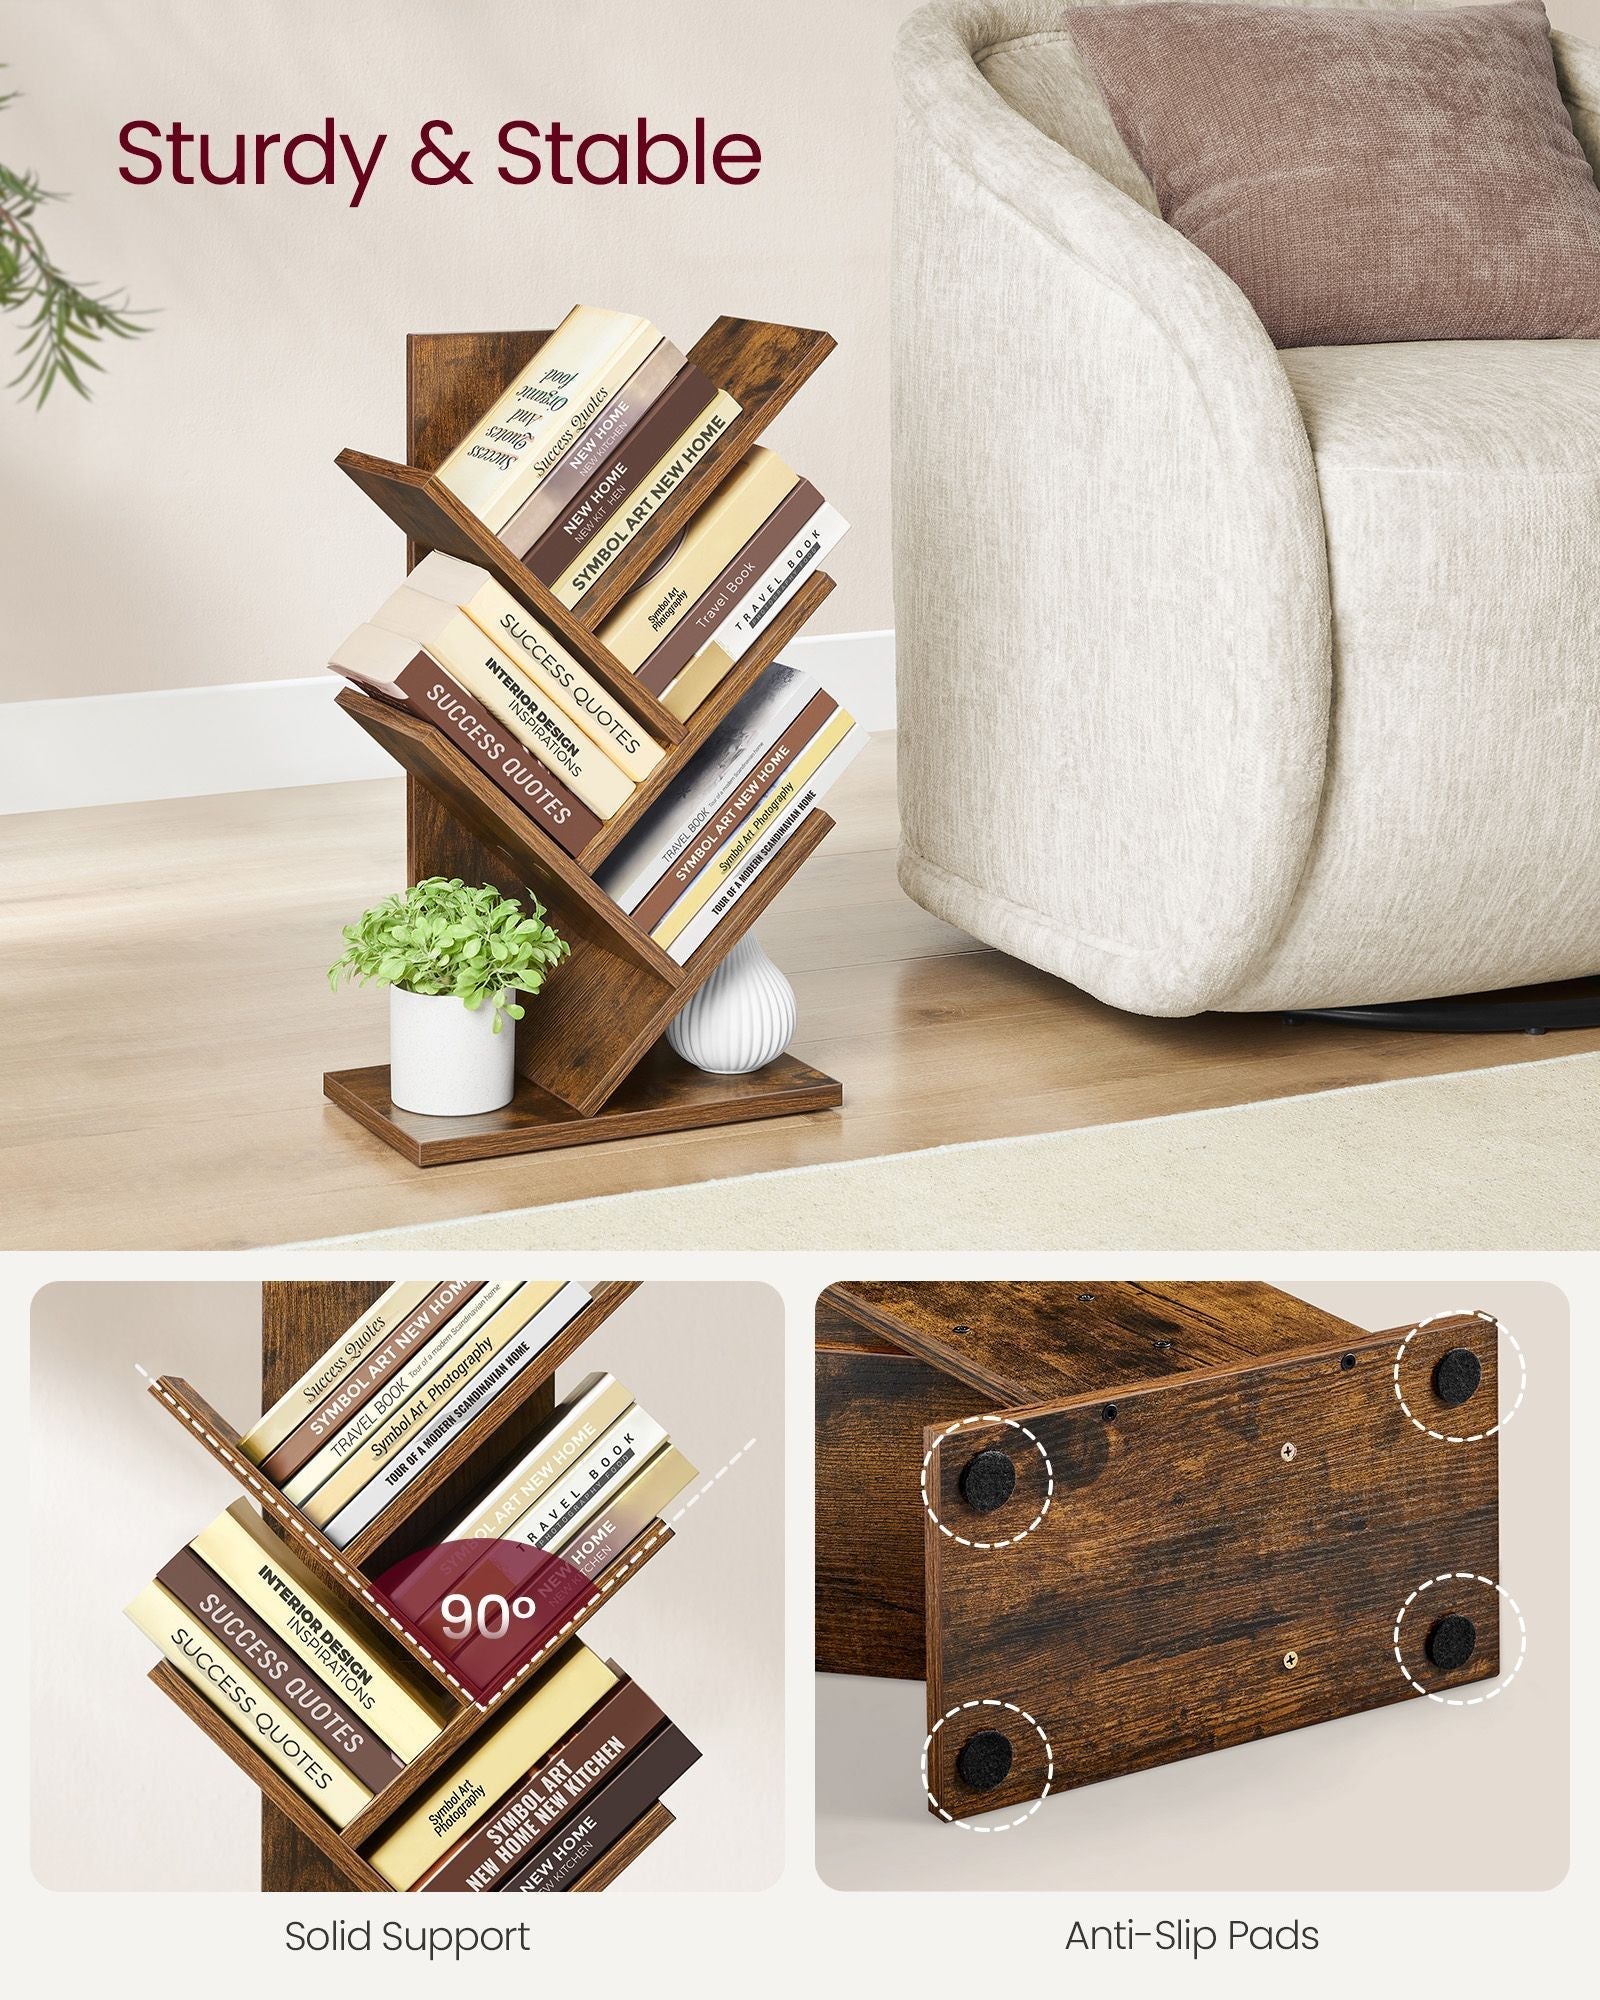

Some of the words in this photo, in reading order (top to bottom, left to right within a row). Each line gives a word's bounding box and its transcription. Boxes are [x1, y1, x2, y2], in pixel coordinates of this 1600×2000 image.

[506, 408, 543, 427] And
[516, 385, 568, 412] Organic
[534, 430, 574, 478] Success
[571, 387, 608, 433] Quotes
[569, 438, 597, 470] NEW
[595, 401, 630, 438] HOME
[467, 445, 519, 471] Success
[580, 457, 598, 476] NEW
[597, 422, 628, 456] KITCHEN
[563, 500, 593, 535] NEW
[590, 462, 628, 504] HOME
[572, 530, 629, 591] SYMBOL
[625, 496, 654, 532] ART
[650, 460, 685, 500] NEW
[682, 414, 726, 464] HOME
[574, 523, 594, 544] NEW
[648, 598, 670, 624] Symbol
[668, 586, 680, 601] Art
[652, 590, 688, 632] Photography
[696, 593, 729, 628] Travel
[726, 562, 756, 593] Book
[734, 577, 782, 631] TRAVEL
[787, 529, 820, 569] BOOK
[485, 657, 538, 715] INTERIOR
[536, 710, 580, 757] DESIGN
[500, 614, 574, 688] SUCCESS
[574, 688, 640, 754] QUOTES
[426, 684, 506, 760] SUCCESS
[502, 758, 572, 824] QUOTES
[508, 700, 582, 778] INSPIRATIONS
[662, 832, 691, 863] TRAVEL
[688, 808, 710, 833] BOOK
[676, 834, 718, 881] SYMBOL
[716, 810, 738, 835] ART
[734, 782, 760, 811] NEW
[759, 744, 790, 782] HOME
[719, 841, 744, 873] Symbol
[742, 830, 754, 845] Art
[752, 782, 794, 830] Photography
[761, 807, 801, 856] SCANDINAVIAN
[798, 790, 816, 812] HOME
[712, 894, 729, 915] TOUR
[726, 885, 738, 897] OF
[735, 878, 742, 887] A
[738, 854, 764, 884] MODERN
[303, 1357, 348, 1403] Success
[344, 1314, 386, 1361] Quotes
[310, 1376, 370, 1435] SYMBOL
[367, 1346, 398, 1380] ART
[395, 1312, 434, 1350] NEW
[330, 1413, 378, 1458] TRAVEL
[375, 1377, 410, 1414] BOOK
[408, 1364, 424, 1378] Tour
[432, 1334, 452, 1356] modern
[451, 1300, 486, 1336] Scandinavian
[484, 1284, 501, 1301] home
[371, 1414, 412, 1458] Symbol
[407, 1400, 428, 1422] Art
[428, 1336, 493, 1402] Photography
[385, 1463, 409, 1486] TOUR
[406, 1450, 422, 1466] OF
[419, 1442, 426, 1456] A
[423, 1414, 457, 1448] MODERN
[454, 1362, 509, 1419] SCANDINAVIAN
[505, 1340, 530, 1367] HOME
[494, 1494, 524, 1526] ART
[520, 1462, 554, 1498] NEW
[552, 1422, 596, 1466] HOME
[516, 1490, 580, 1553] TRAVEL
[588, 1432, 635, 1480] BOOK
[538, 1480, 602, 1547] PHOTOGRAPHY
[604, 1454, 629, 1479] FOOD
[538, 1560, 573, 1598] NEW
[570, 1520, 616, 1566] HOME
[258, 1565, 323, 1634] INTERIOR
[320, 1629, 372, 1686] DESIGN
[286, 1616, 376, 1710] INSPIRATIONS
[171, 1628, 257, 1712] SUCCESS
[256, 1712, 332, 1790] QUOTES
[200, 1594, 288, 1680] SUCCESS
[284, 1678, 364, 1753] QUOTES
[428, 1791, 460, 1826] Symbol
[458, 1779, 474, 1796] Art
[434, 1784, 486, 1838] Photography
[466, 1858, 500, 1892] NEW
[495, 1818, 540, 1864] HOME
[534, 1793, 568, 1827] NEW
[563, 1736, 626, 1799] KITCHEN
[486, 1788, 546, 1845] SYMBOL
[540, 1759, 574, 1792] ART
[520, 1858, 554, 1892] NEW
[552, 1816, 598, 1862] HOME
[537, 1878, 555, 1892] EW
[554, 1841, 594, 1882] KITCHEN
